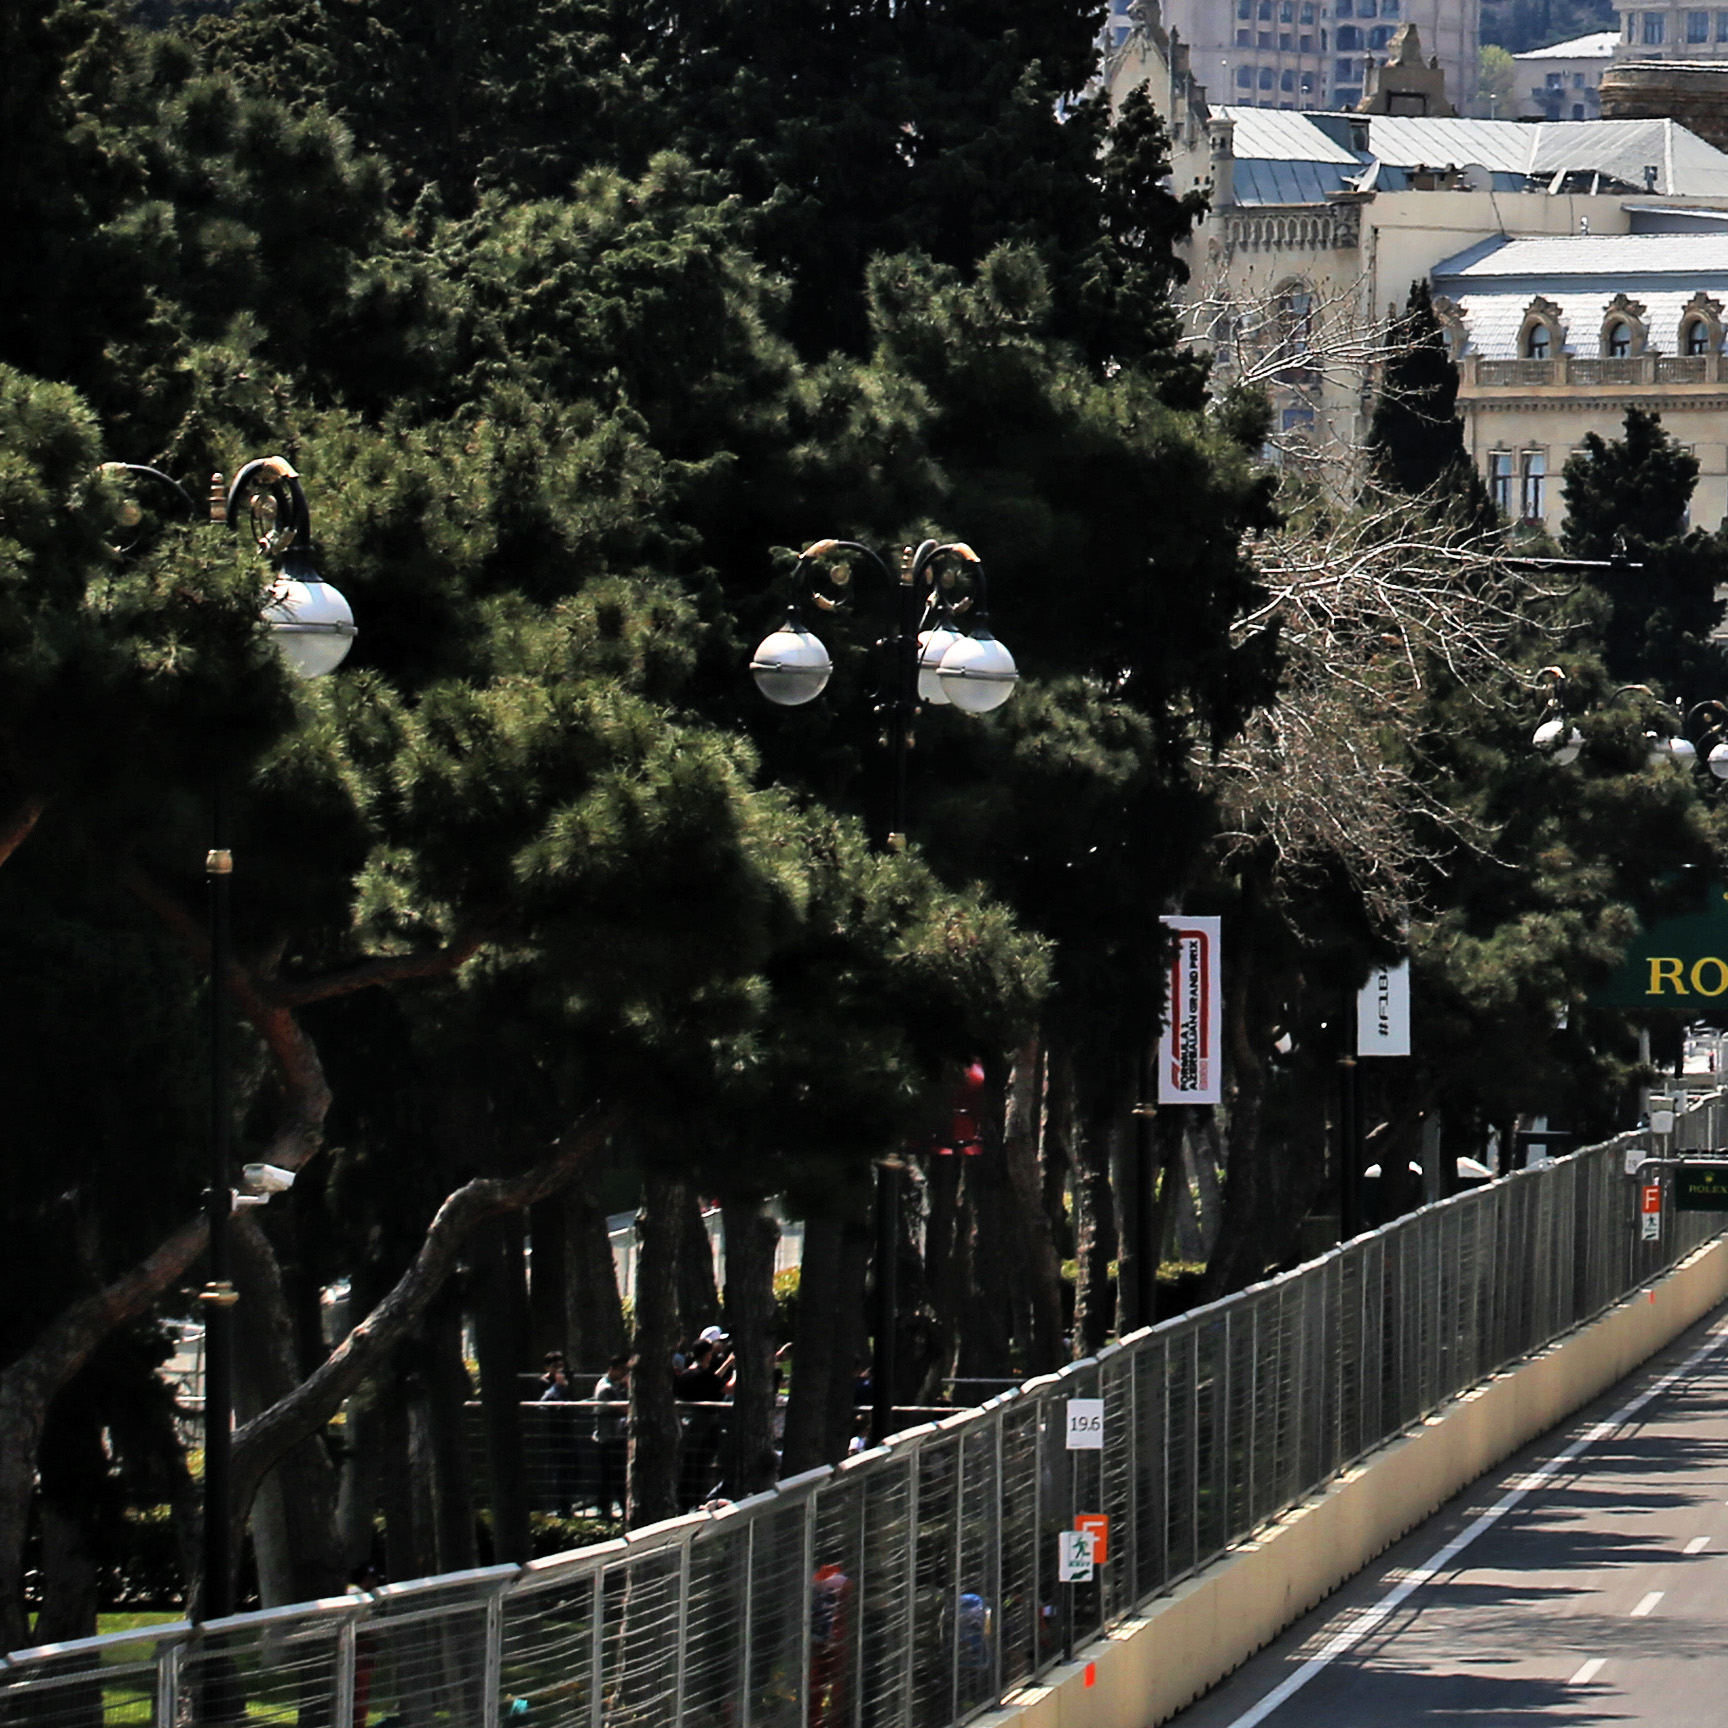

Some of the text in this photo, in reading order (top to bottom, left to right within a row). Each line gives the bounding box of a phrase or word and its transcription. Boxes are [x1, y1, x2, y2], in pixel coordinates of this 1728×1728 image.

[1189, 940, 1198, 1091] AZERBAIJAN GRAND PRIX
[1180, 1032, 1189, 1091] FORMULA
[1645, 1188, 1658, 1210] F
[1070, 1416, 1101, 1432] 19.6
